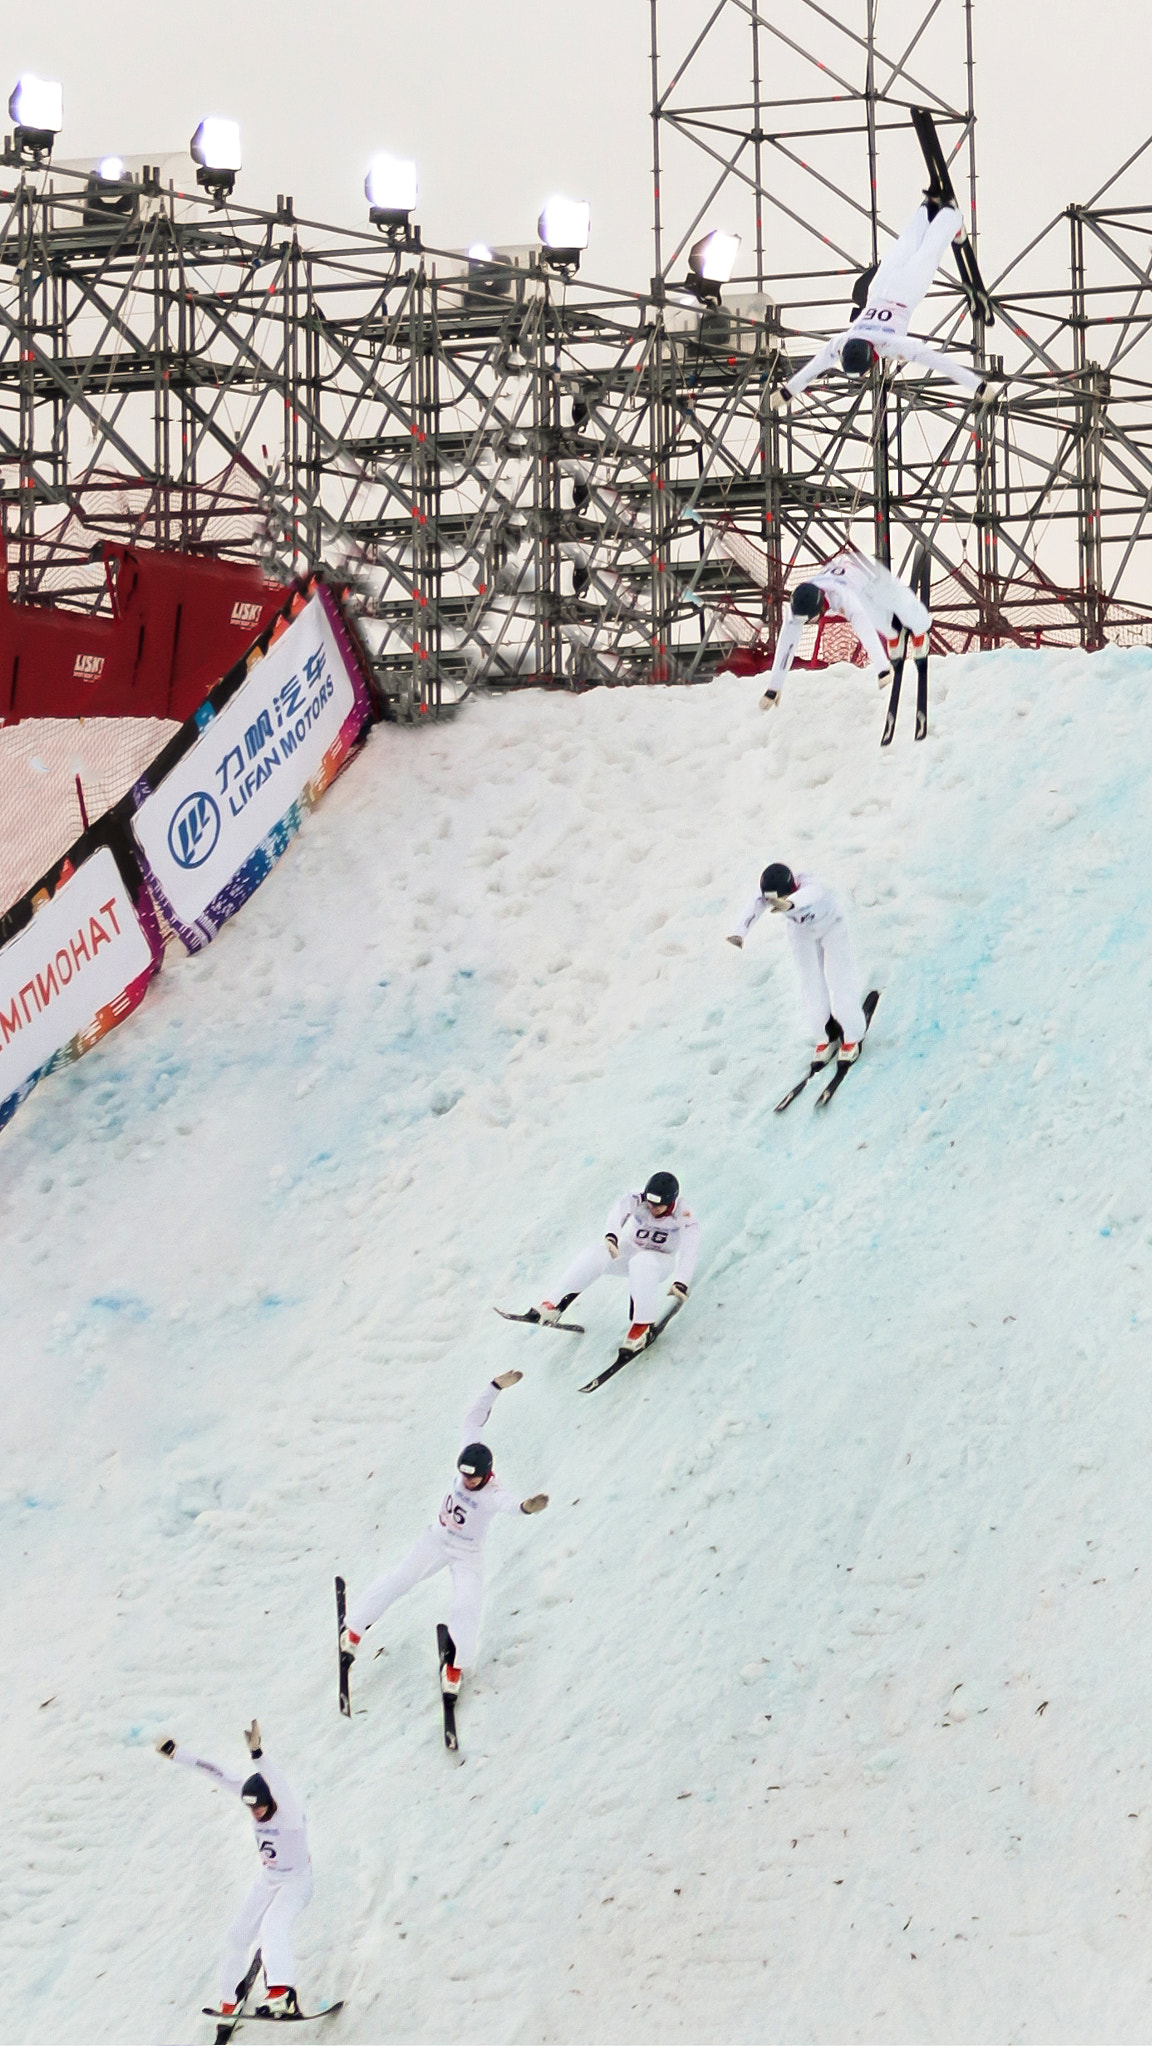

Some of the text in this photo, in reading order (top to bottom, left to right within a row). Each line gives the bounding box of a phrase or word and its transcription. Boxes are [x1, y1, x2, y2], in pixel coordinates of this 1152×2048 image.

[215, 642, 327, 796] 力帆汽车
[228, 674, 335, 818] LIFAN MOTORS
[0, 896, 121, 1051] МПИОНАТ
